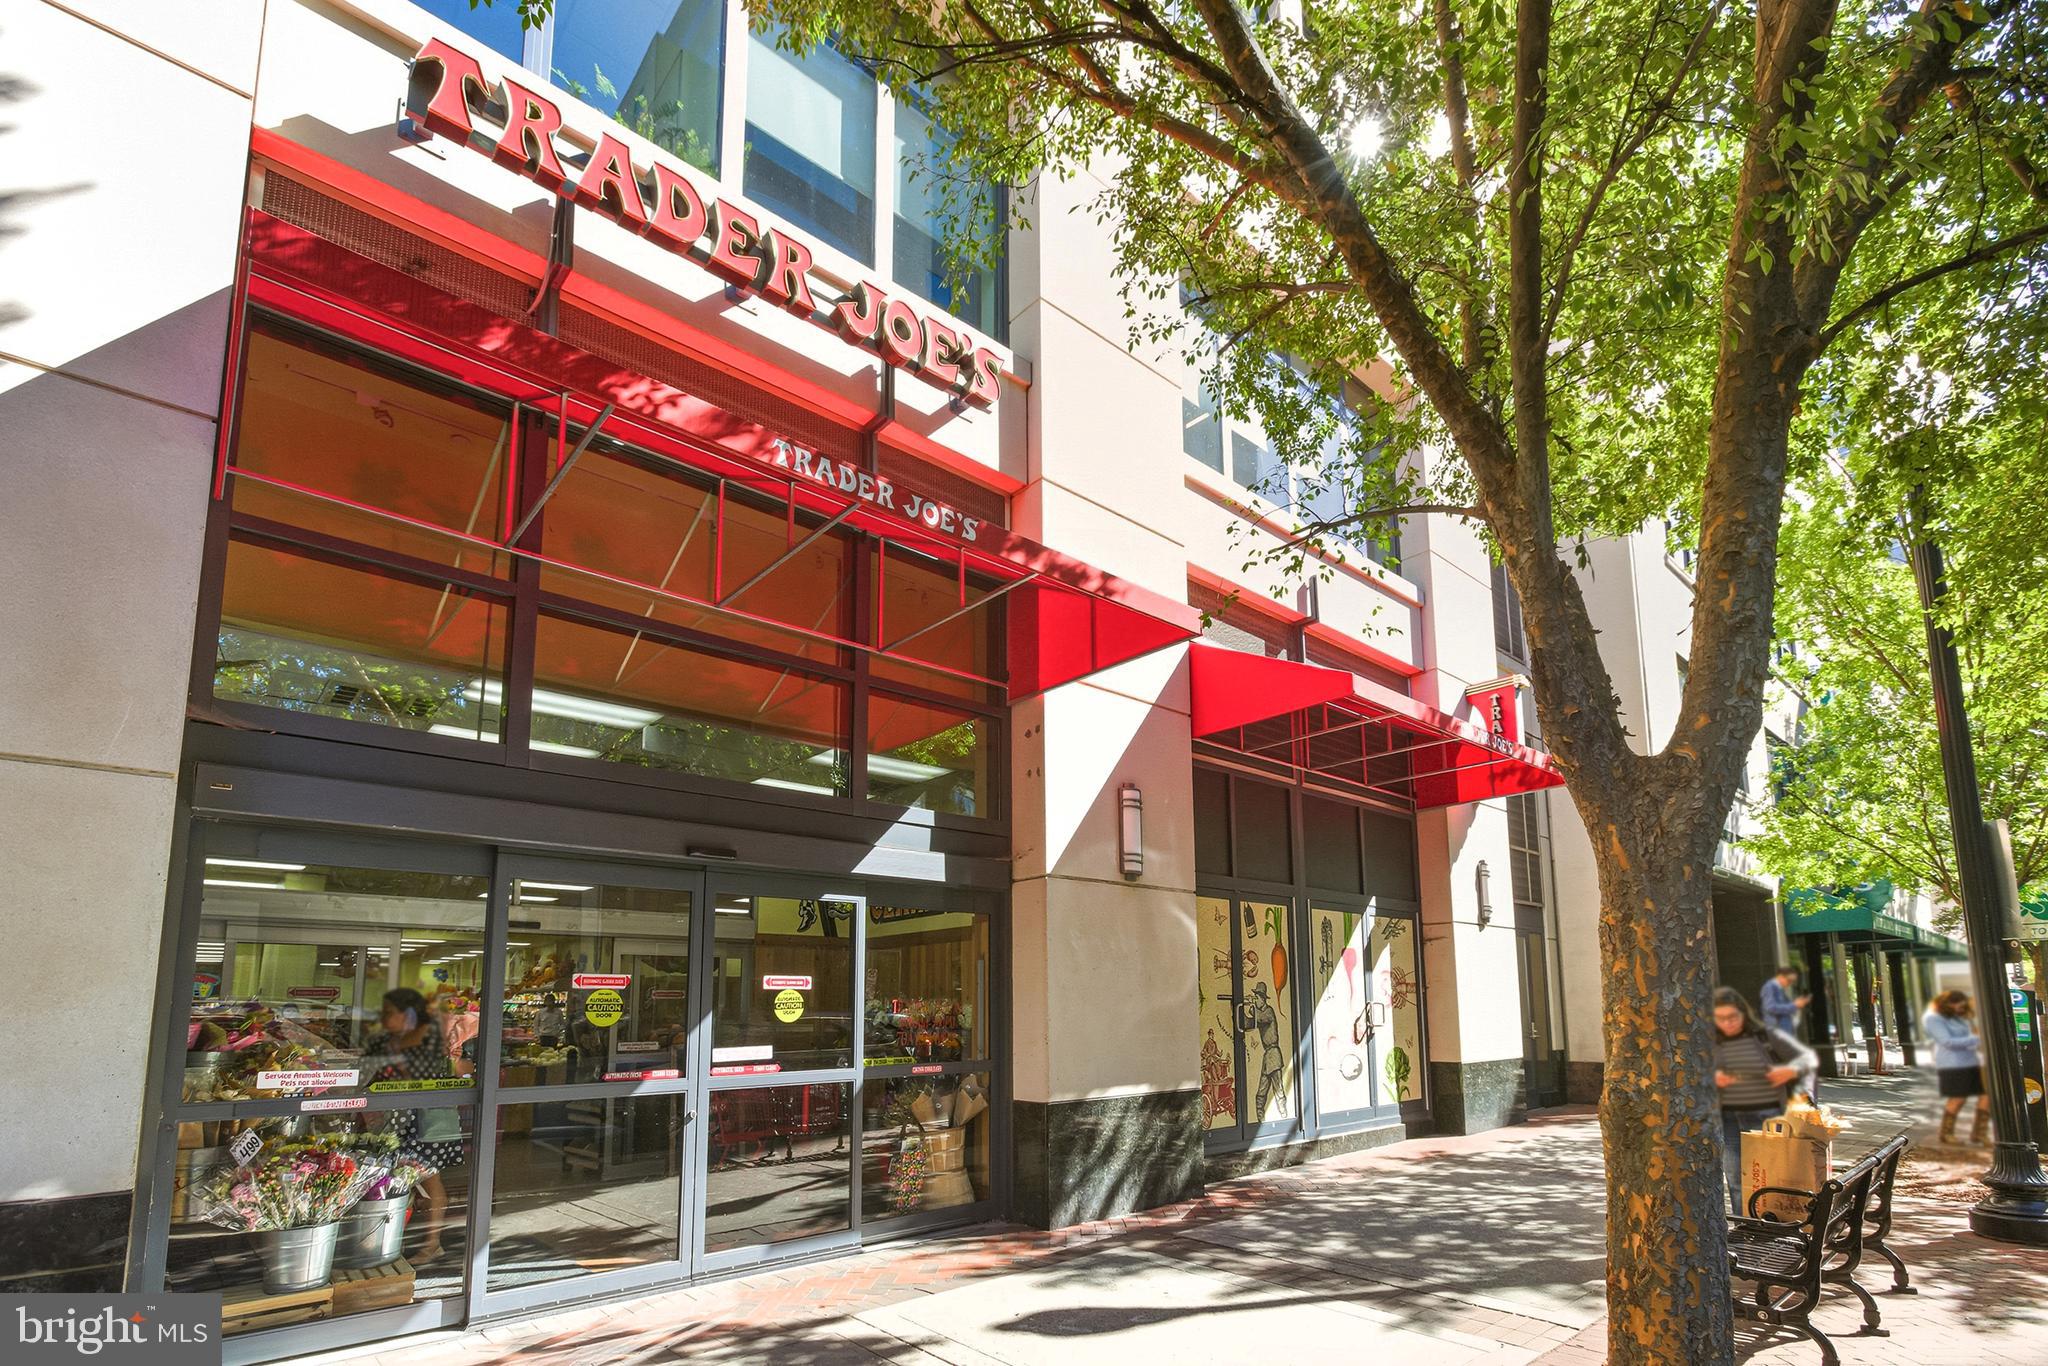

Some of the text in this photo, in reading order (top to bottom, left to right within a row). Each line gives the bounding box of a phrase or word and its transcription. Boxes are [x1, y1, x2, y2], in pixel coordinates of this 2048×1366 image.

[408, 37, 1004, 410] TRADER JOE'S
[771, 438, 979, 542] TRADER JOE'S
[587, 1004, 621, 1012] CAUTION
[775, 1002, 803, 1010] CAUTION
[264, 1070, 353, 1080] Service Animals Welcome
[280, 1079, 296, 1087] Pets
[310, 1078, 337, 1086] allowed
